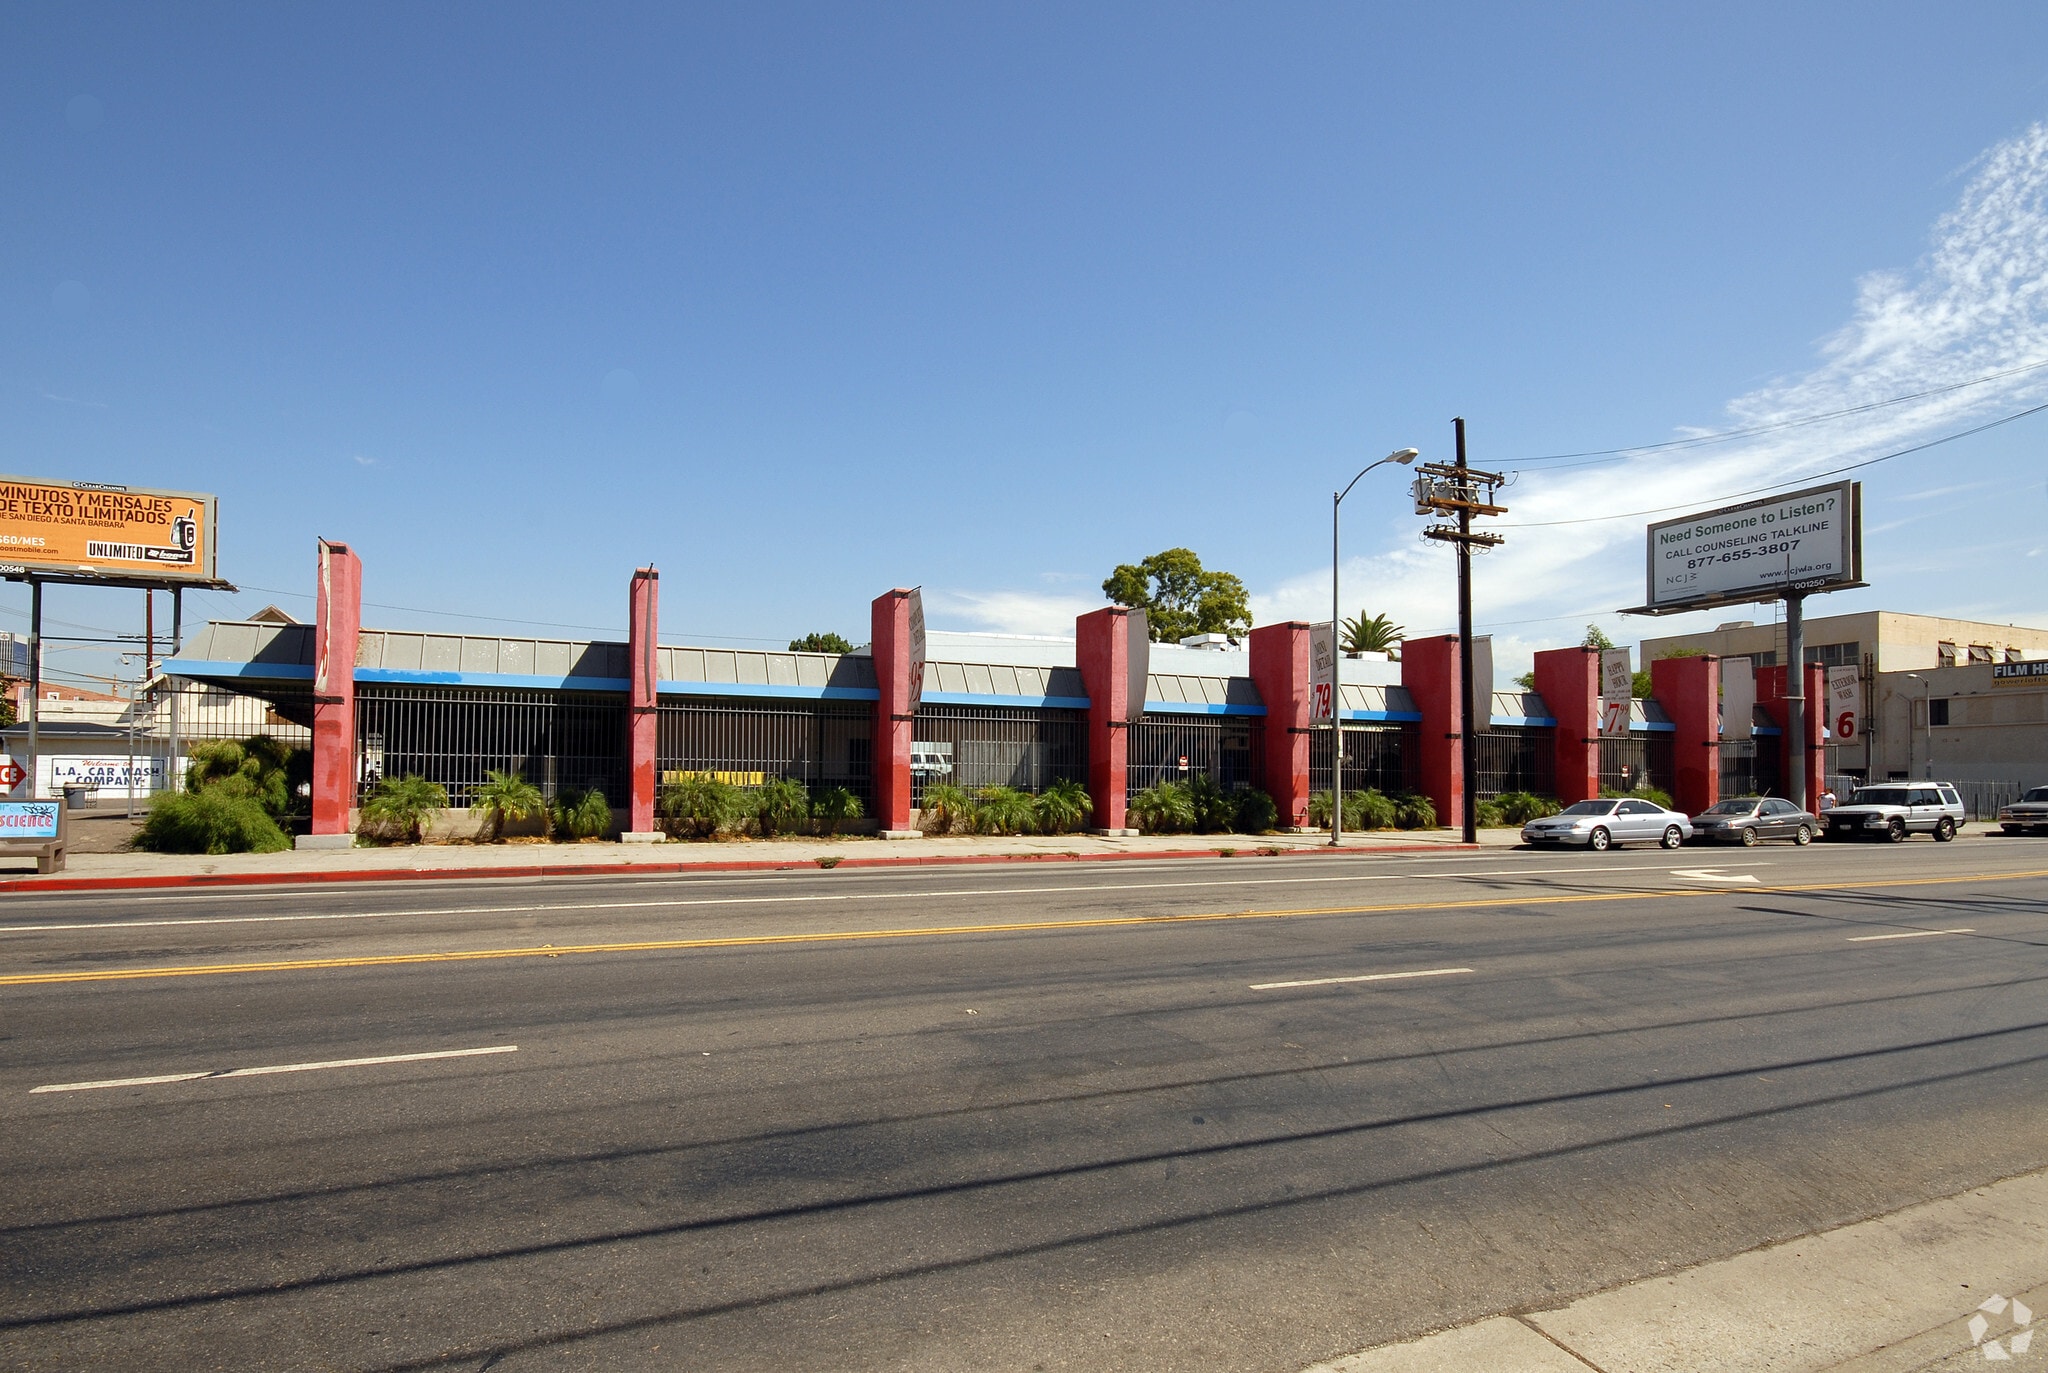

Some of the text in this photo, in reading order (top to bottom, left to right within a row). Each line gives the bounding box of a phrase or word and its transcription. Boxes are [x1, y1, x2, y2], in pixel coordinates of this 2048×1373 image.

[0, 486, 172, 513] MINUTOS Y MENSAJES
[9, 513, 26, 521] SAN
[27, 514, 52, 523] DIEGO
[53, 516, 60, 524] A
[60, 517, 87, 526] SANTA
[87, 519, 125, 529] BARBARA
[23, 500, 74, 518] TEXTO
[78, 505, 171, 526] ILIMITADOS.
[1659, 498, 1836, 546] Need Someone to Listen?
[1665, 520, 1830, 560] CALL COUNSELING TALKLINE
[89, 542, 144, 560] UNLIMITED
[1687, 539, 1801, 570] 877-655-3807
[1794, 578, 1826, 590] 001250
[1994, 664, 2028, 678] FILM
[55, 766, 161, 777] L.A. CAR WASH
[82, 759, 120, 768] Welcome
